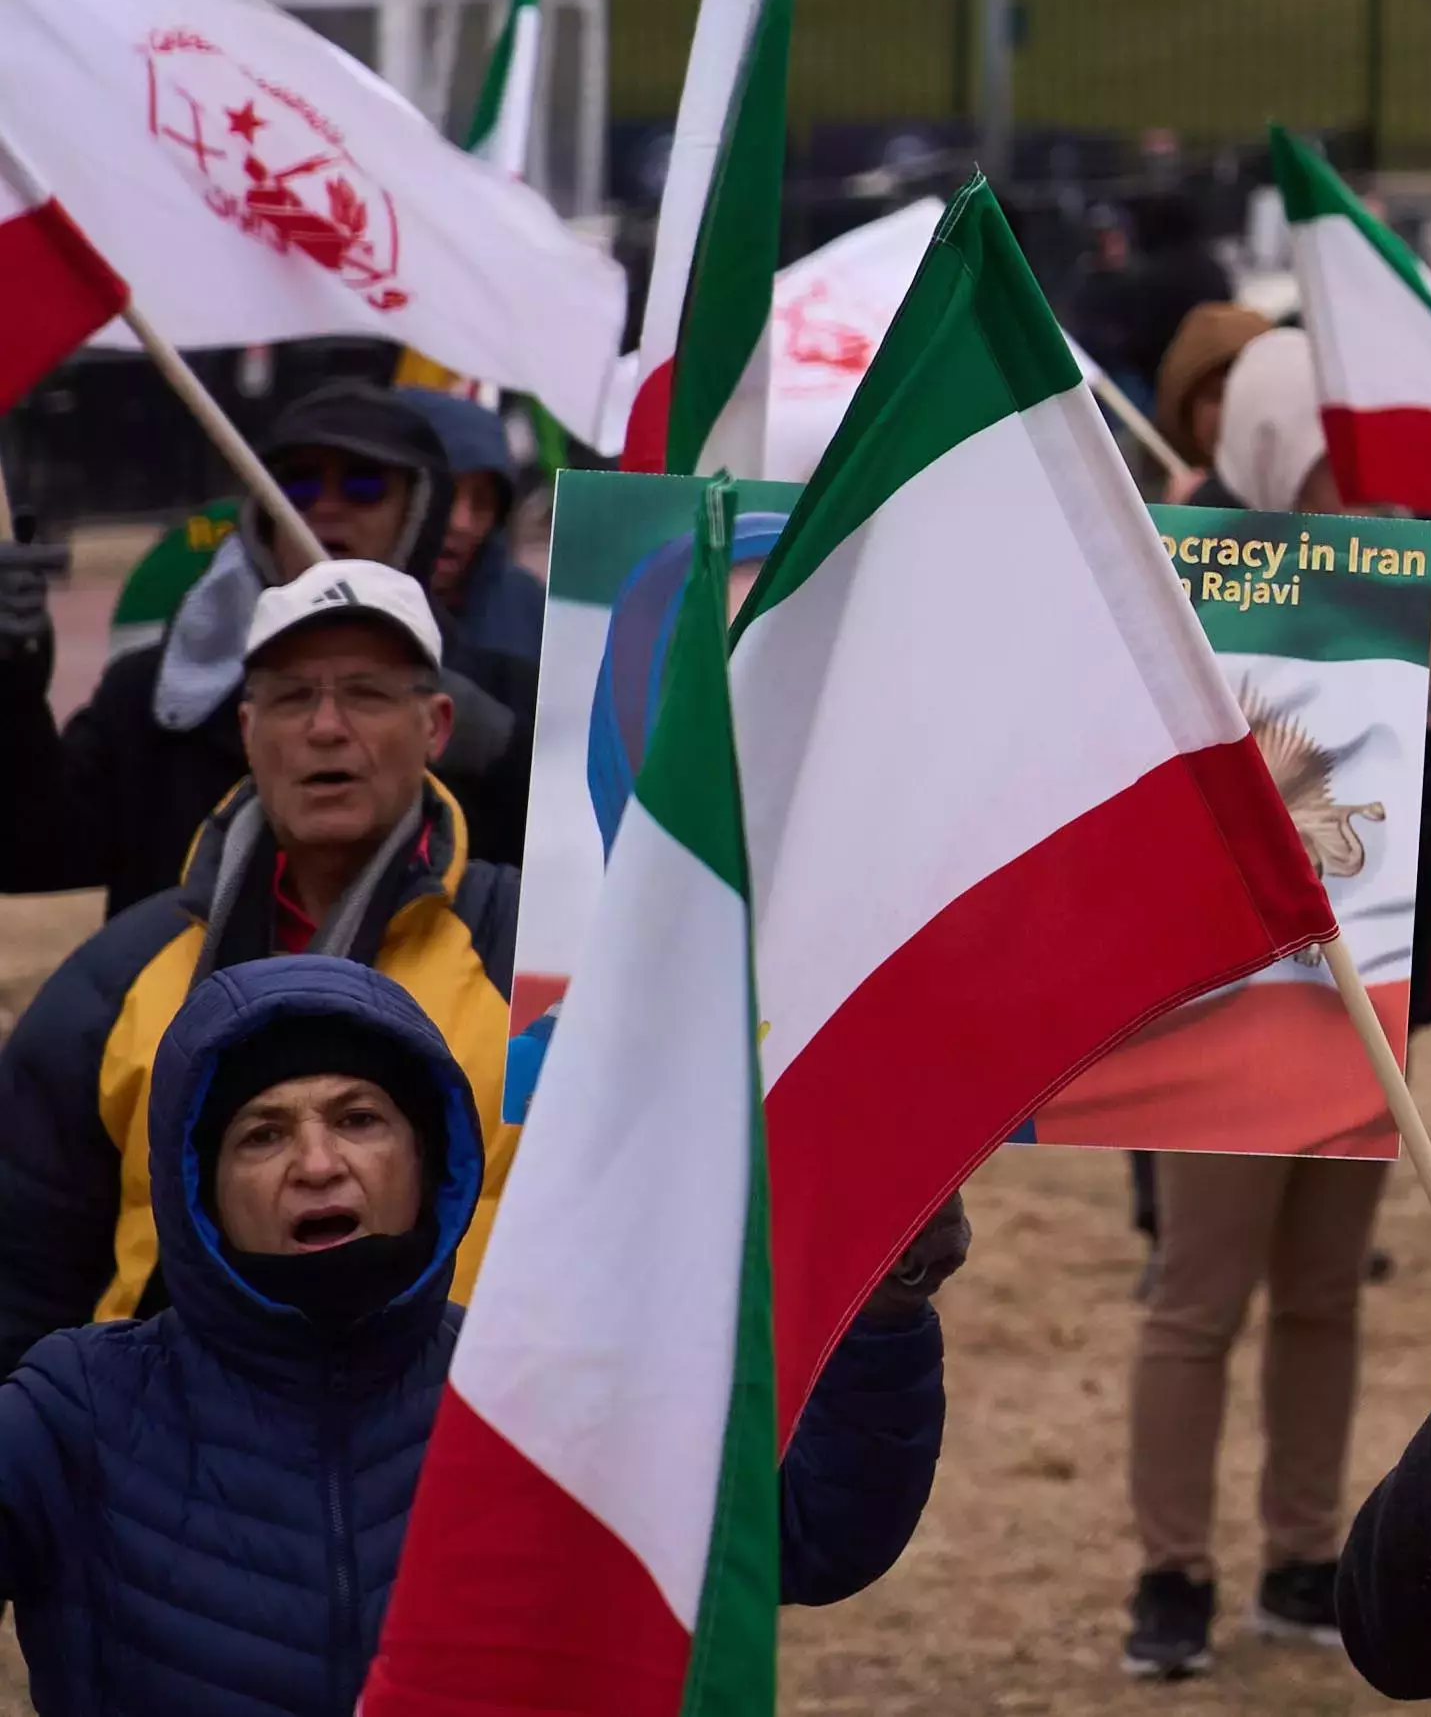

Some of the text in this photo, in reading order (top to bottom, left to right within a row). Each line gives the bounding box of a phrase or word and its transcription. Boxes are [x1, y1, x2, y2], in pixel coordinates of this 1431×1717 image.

[1159, 531, 1426, 579] ocracy in Iran
[1201, 570, 1300, 611] Rajavi
